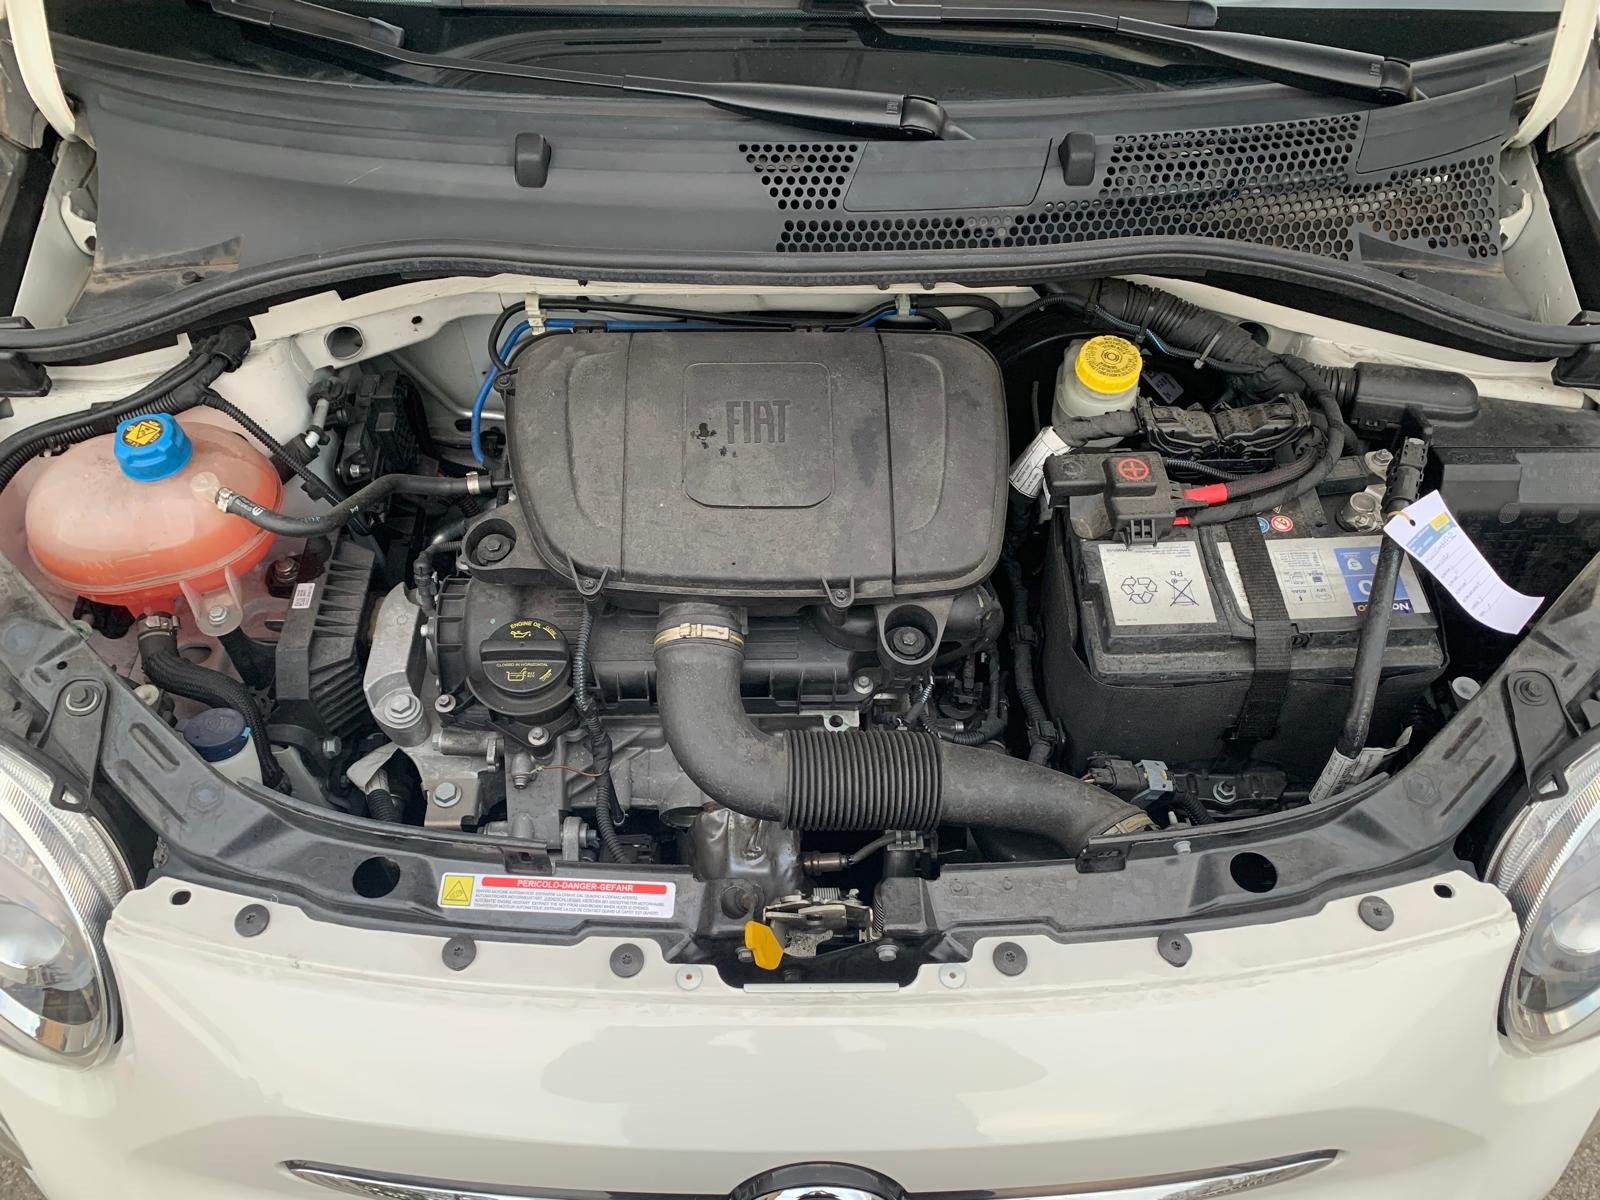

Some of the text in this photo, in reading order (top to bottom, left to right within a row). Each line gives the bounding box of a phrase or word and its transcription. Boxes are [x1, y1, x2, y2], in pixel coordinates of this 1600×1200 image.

[726, 400, 791, 445] FIAT
[510, 621, 541, 629] ENGINE OIL
[516, 880, 634, 892] PERICOLO-DANGER-GEFAHR
